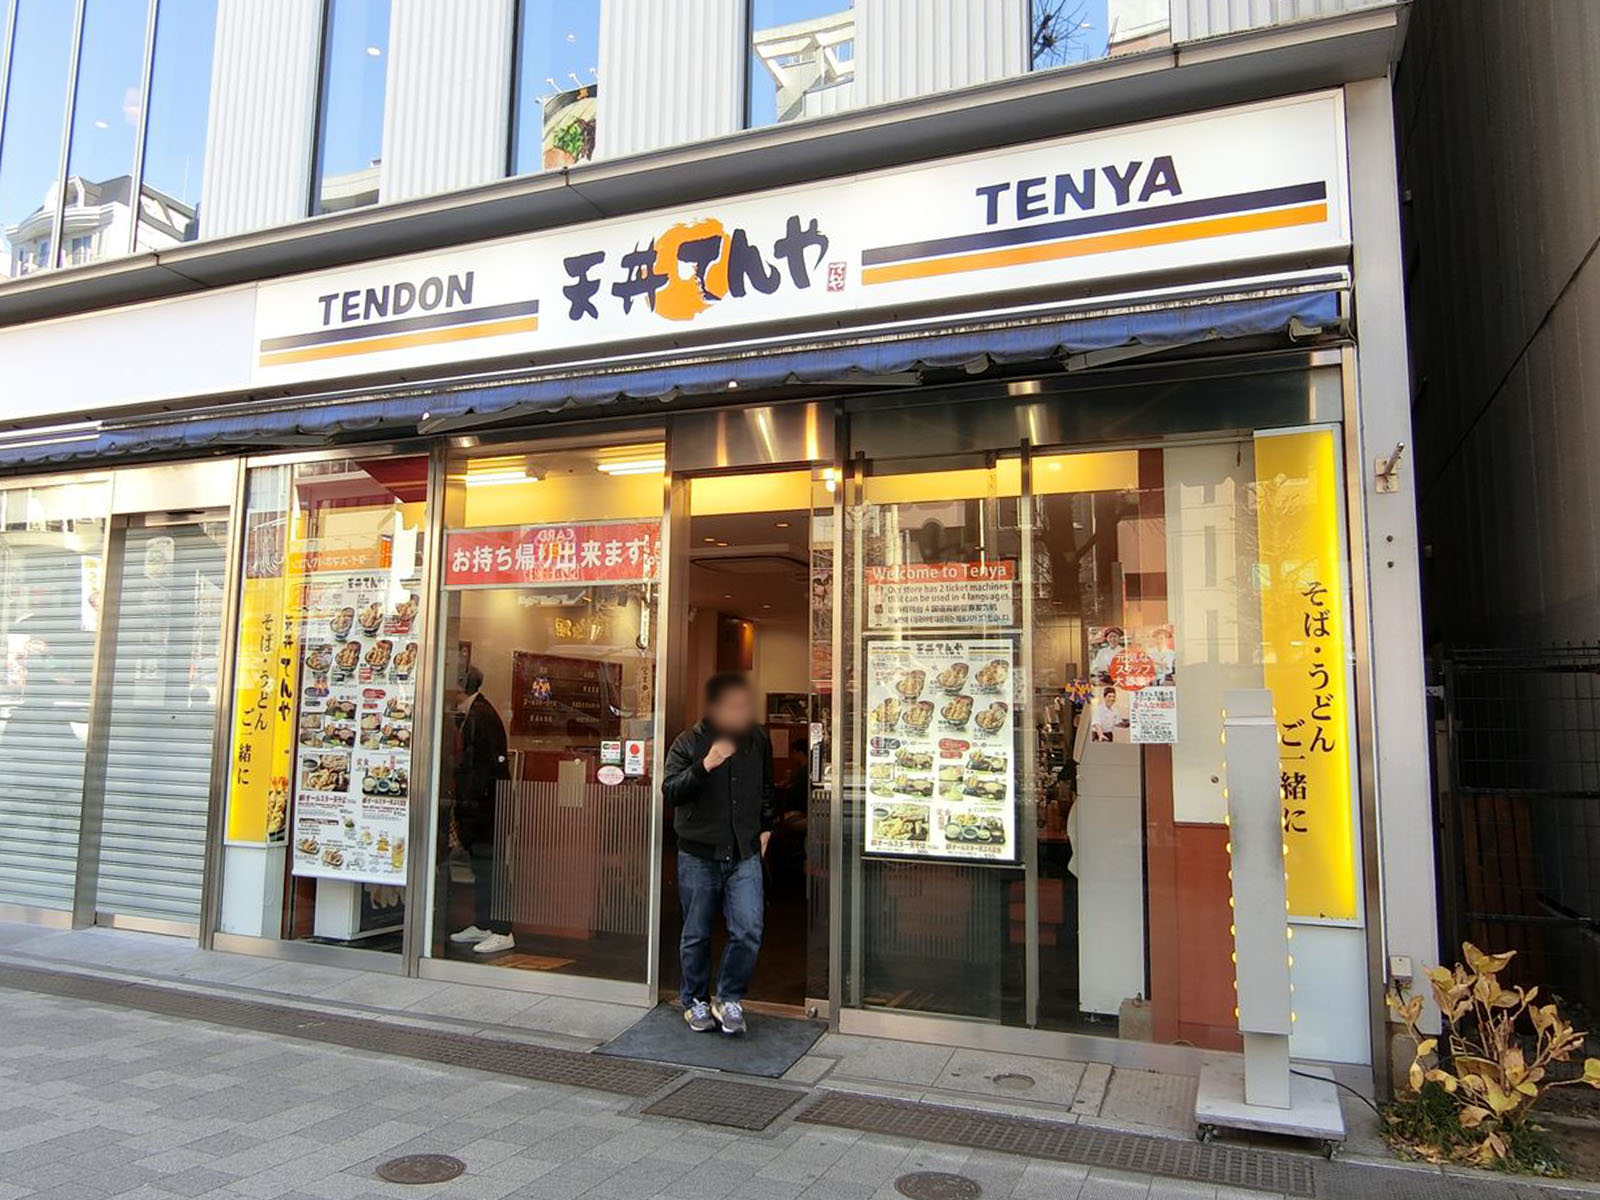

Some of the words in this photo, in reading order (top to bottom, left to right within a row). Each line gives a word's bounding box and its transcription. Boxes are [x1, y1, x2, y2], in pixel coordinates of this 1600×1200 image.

[976, 155, 1183, 225] TENYA
[318, 271, 474, 326] TENDON
[920, 594, 930, 602] be
[931, 593, 950, 602] used
[951, 593, 960, 601] in
[967, 592, 1009, 602] languages
[924, 584, 938, 593] has
[939, 584, 944, 593] 2
[946, 584, 968, 593] ticket
[969, 582, 1008, 592] machines
[943, 568, 958, 578] to
[254, 613, 274, 731] そば・うどん
[1302, 580, 1335, 753] そば・うどん
[237, 708, 255, 786] ご一緒に
[1279, 719, 1308, 833] ご一緒に
